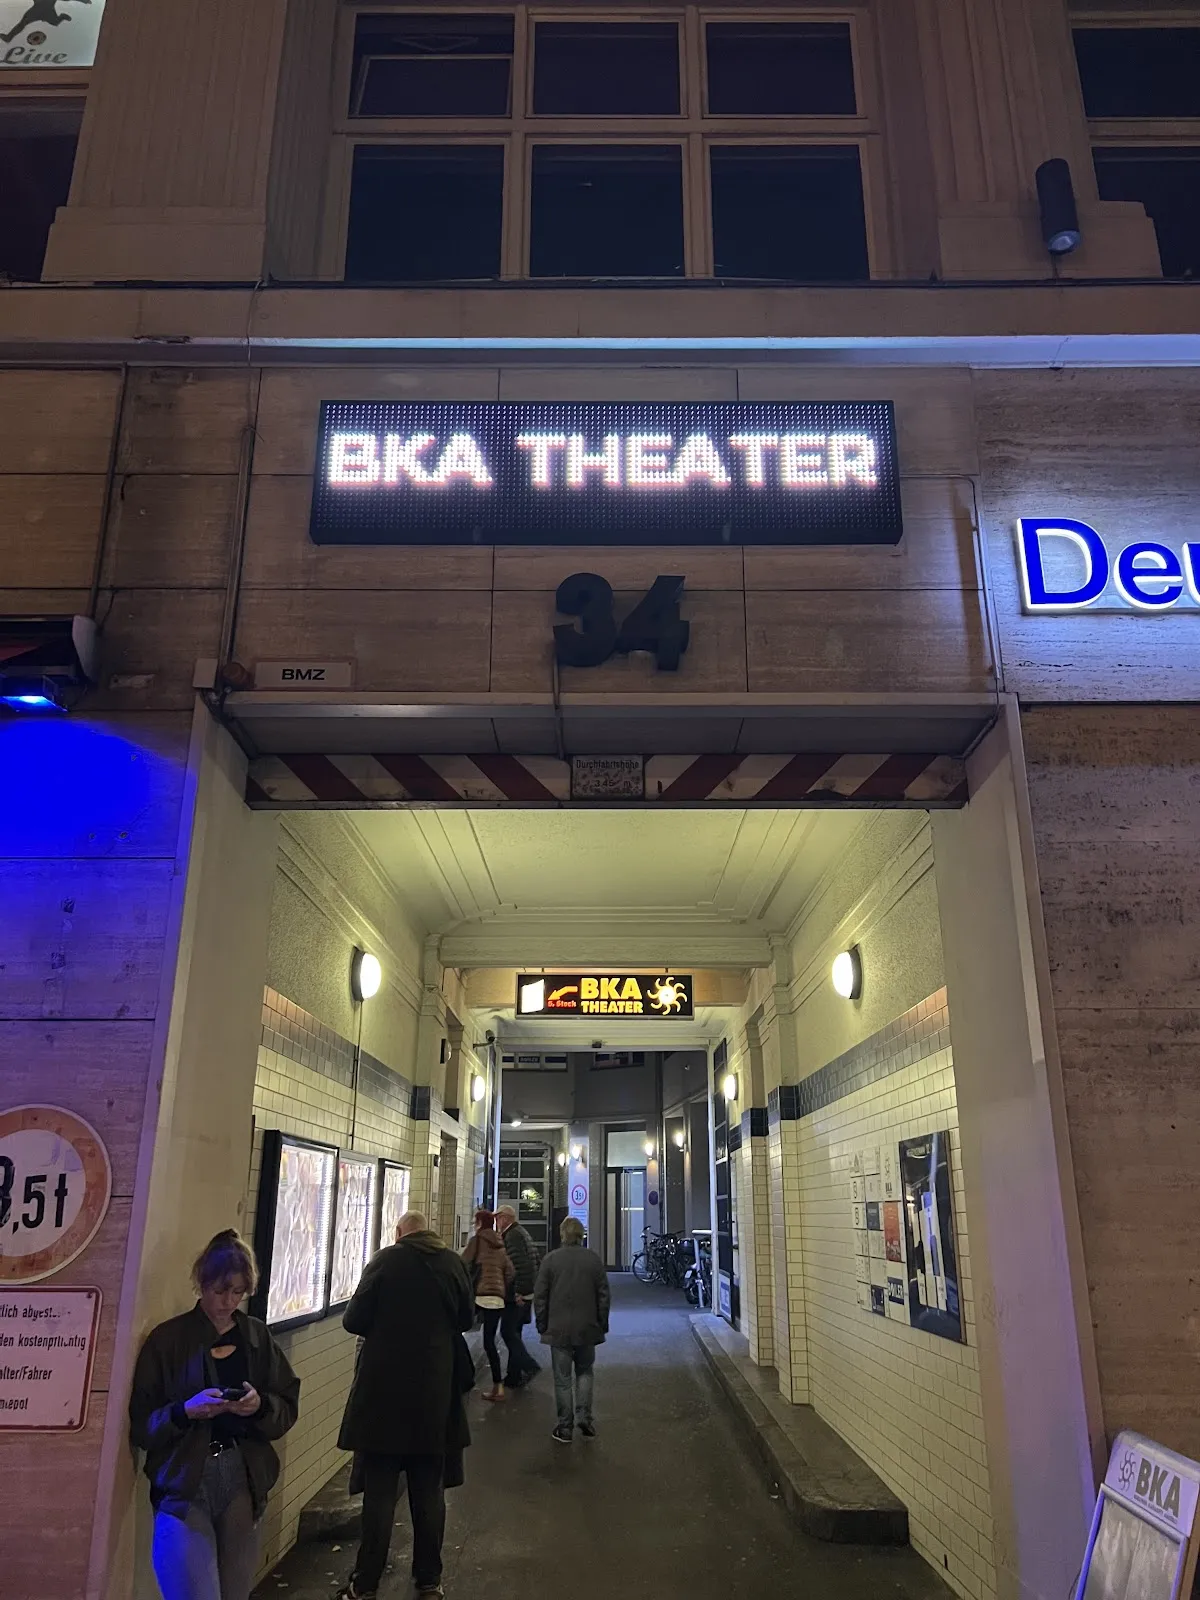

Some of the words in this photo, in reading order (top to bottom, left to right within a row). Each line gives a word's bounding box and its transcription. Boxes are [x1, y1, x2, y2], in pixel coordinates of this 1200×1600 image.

[1, 46, 68, 64] Live
[327, 433, 493, 487] BKA
[515, 433, 877, 487] THEATER
[552, 572, 690, 671] 34
[281, 668, 326, 681] BMZ
[580, 977, 643, 1000] BKA
[556, 1000, 577, 1008] Stock
[580, 1000, 643, 1013] THEATER
[1135, 1457, 1181, 1518] BKA
